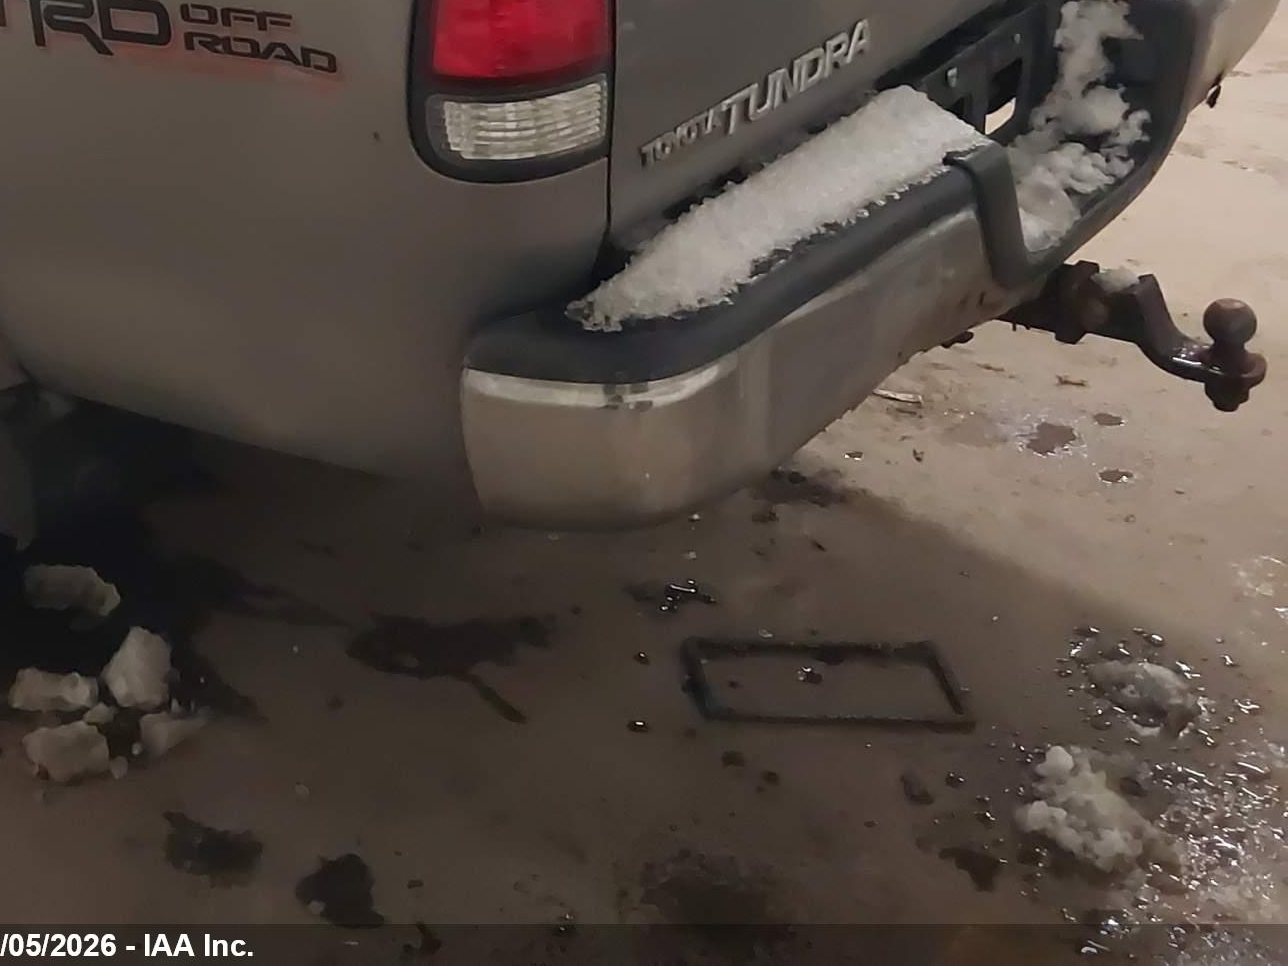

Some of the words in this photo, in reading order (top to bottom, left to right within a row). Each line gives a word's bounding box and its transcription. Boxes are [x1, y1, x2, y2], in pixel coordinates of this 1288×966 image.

[180, 3, 293, 32] OFF
[184, 31, 338, 74] ROAD
[639, 108, 722, 169] TOYOTA
[721, 18, 871, 135] TUNDRA
